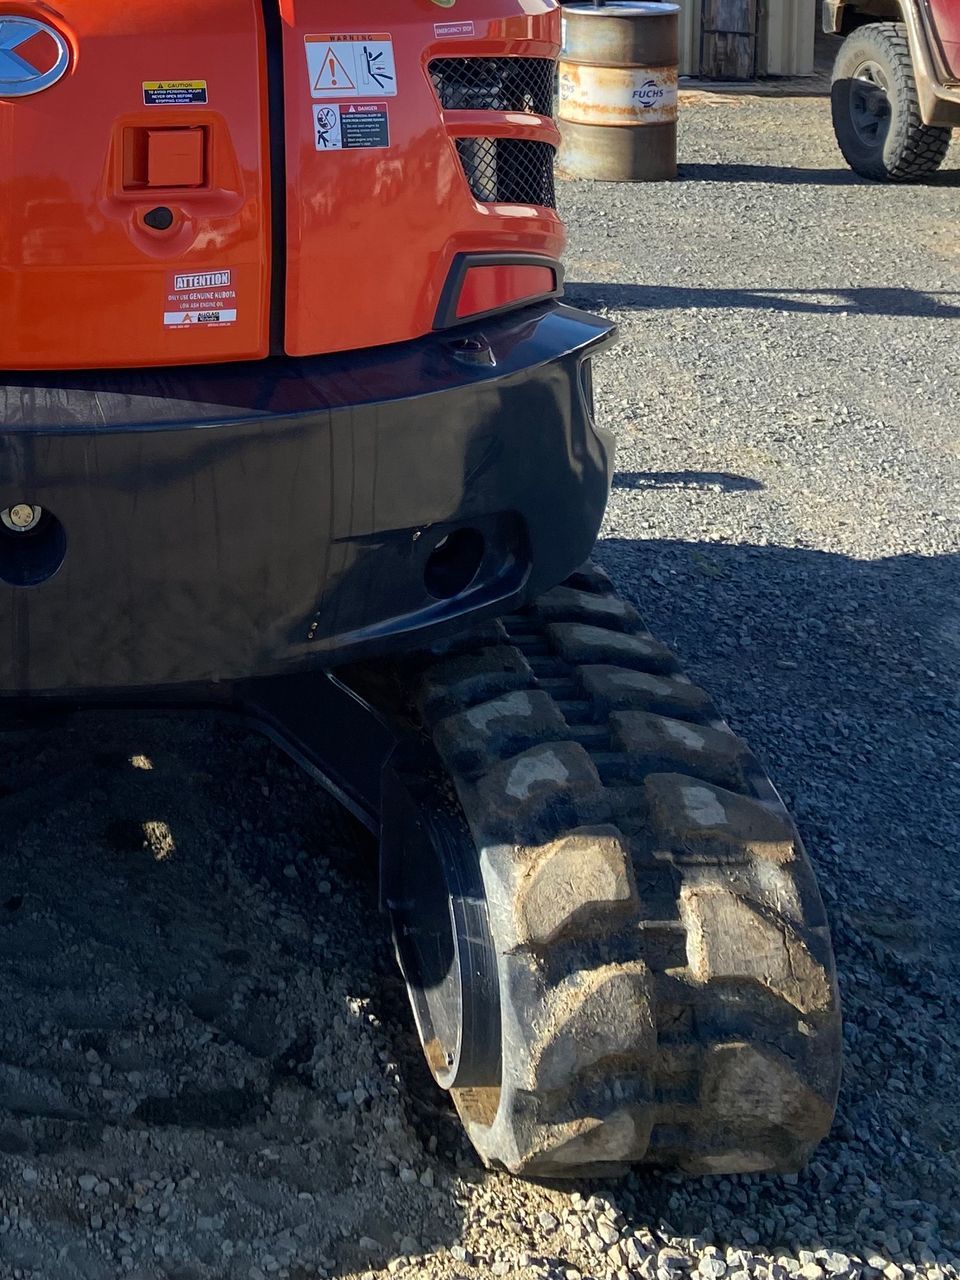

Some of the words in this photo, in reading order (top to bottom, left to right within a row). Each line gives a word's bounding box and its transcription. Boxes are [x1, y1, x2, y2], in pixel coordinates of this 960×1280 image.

[632, 89, 664, 99] FUCHS
[177, 273, 228, 288] ATTENTION
[189, 292, 214, 300] GENUINE
[214, 291, 236, 299] KUBOTA
